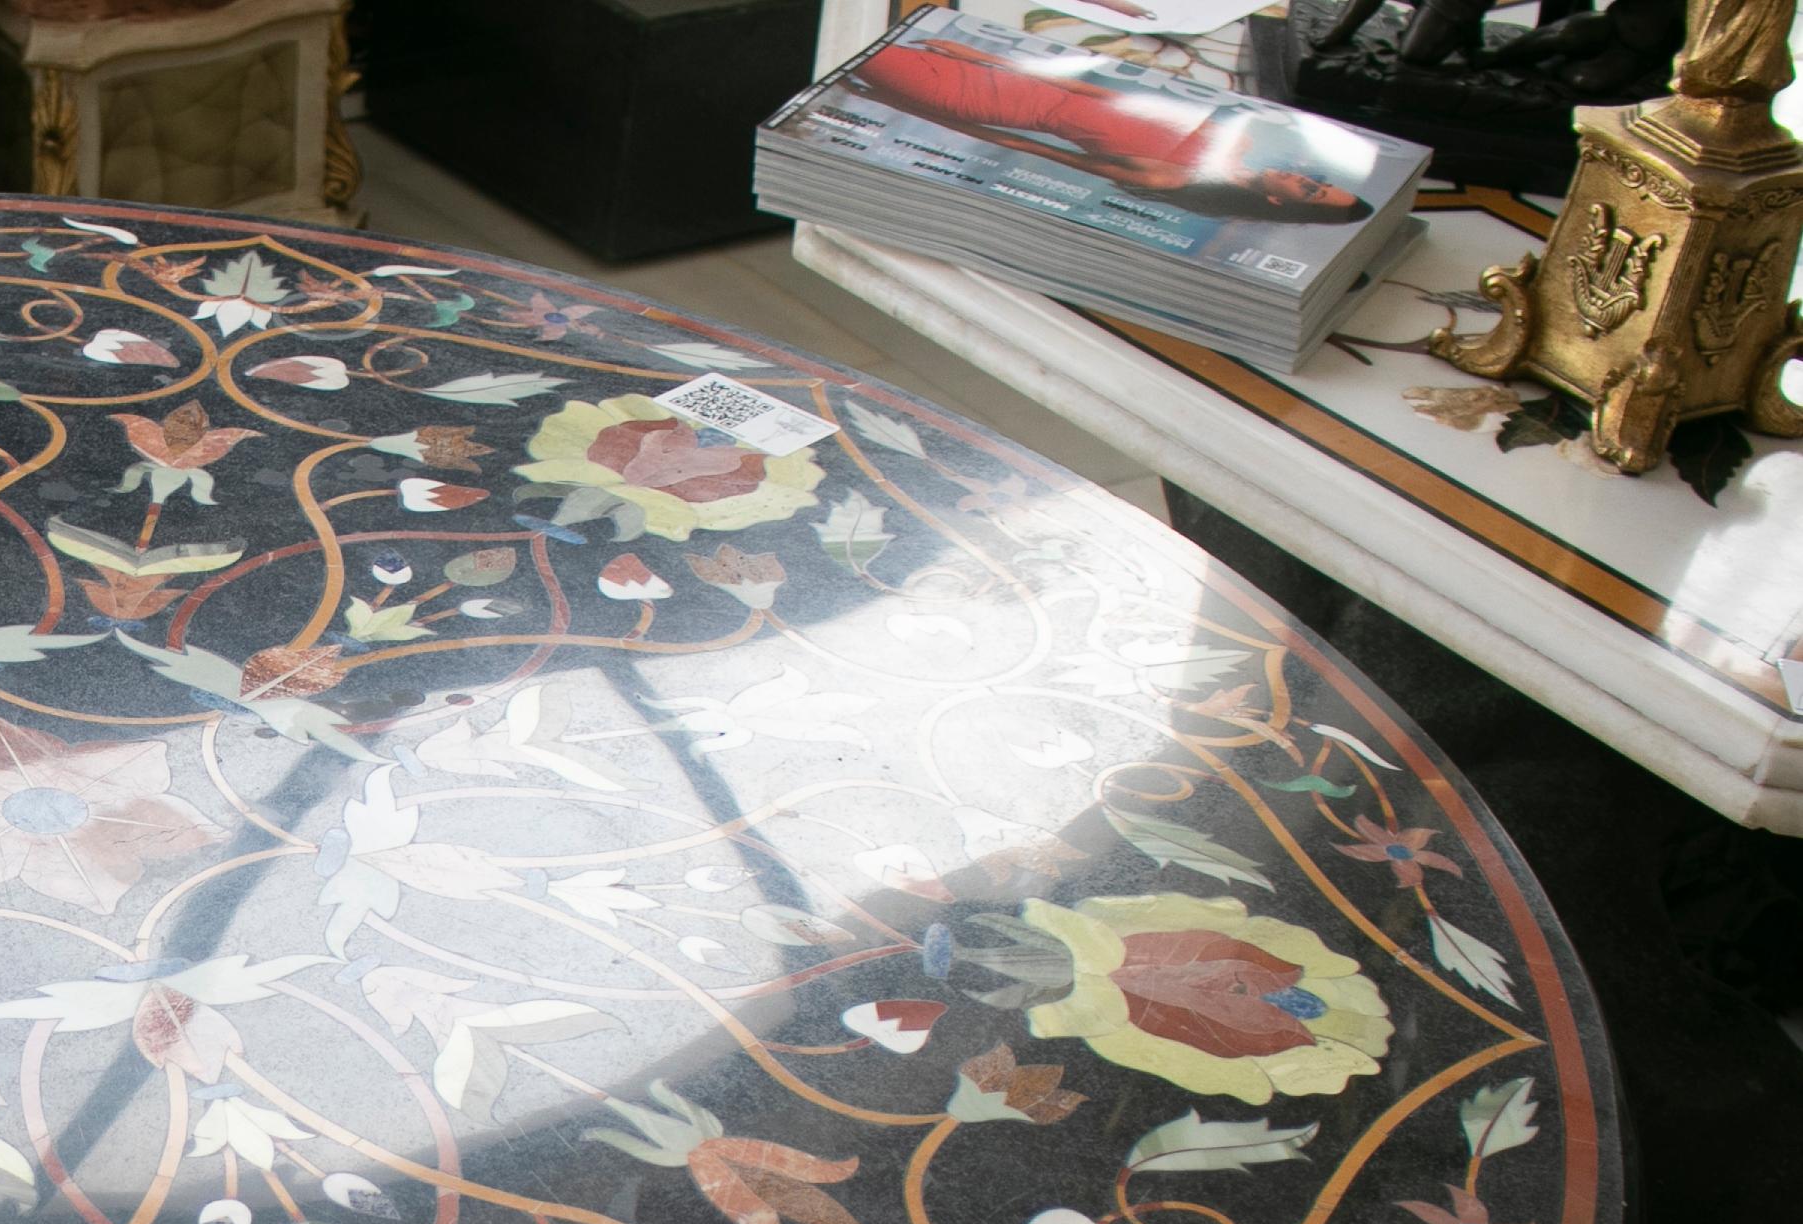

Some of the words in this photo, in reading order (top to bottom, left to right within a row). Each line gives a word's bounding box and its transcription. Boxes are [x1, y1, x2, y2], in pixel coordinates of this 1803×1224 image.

[828, 136, 868, 151] EIZA
[889, 138, 966, 163] MARBELLA
[988, 182, 1072, 211] MAJESTIC
